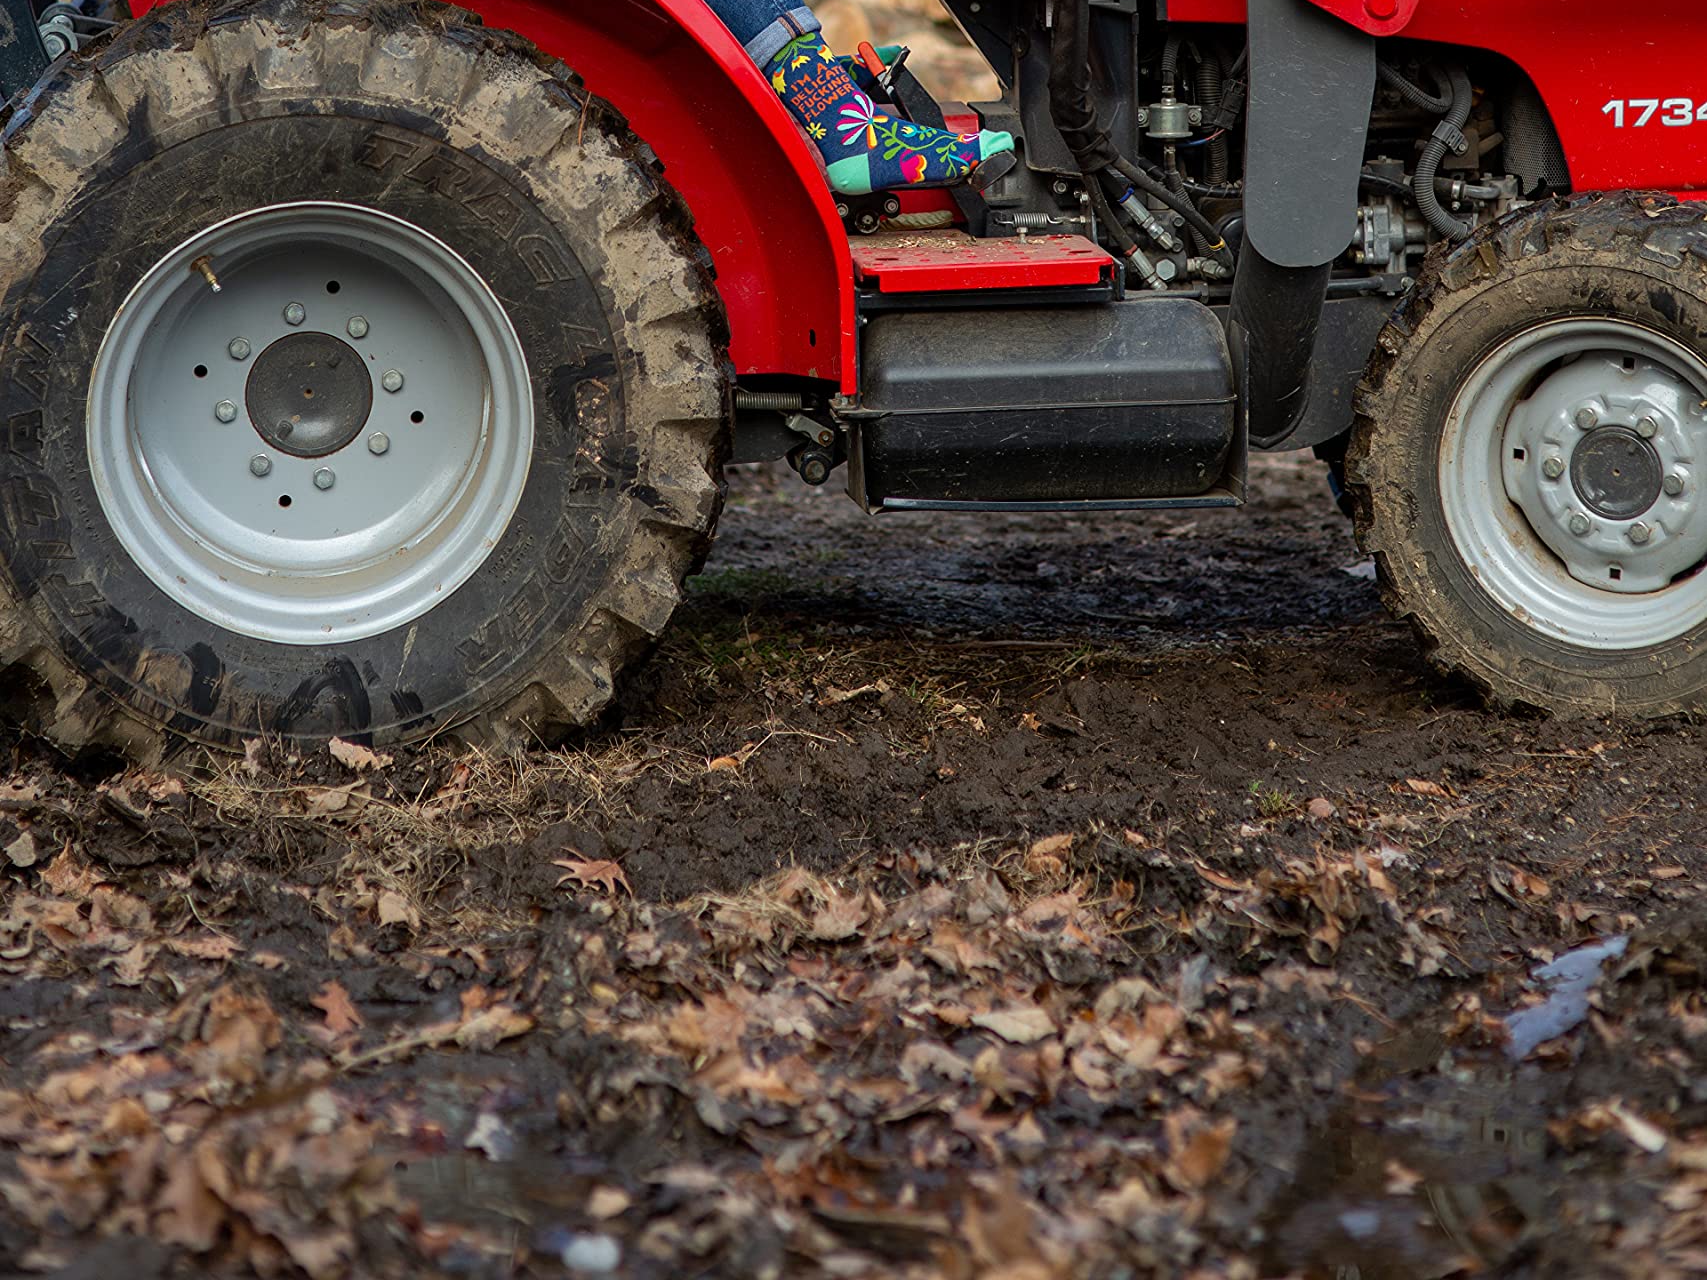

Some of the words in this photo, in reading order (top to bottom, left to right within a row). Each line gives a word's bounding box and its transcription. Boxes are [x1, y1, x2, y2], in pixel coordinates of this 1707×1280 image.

[790, 73, 811, 92] I'M
[817, 62, 828, 75] A
[798, 74, 850, 113] FUCKING
[804, 83, 855, 122] FLOWER
[357, 129, 577, 285] TRAC
[7, 328, 106, 618] TITAN
